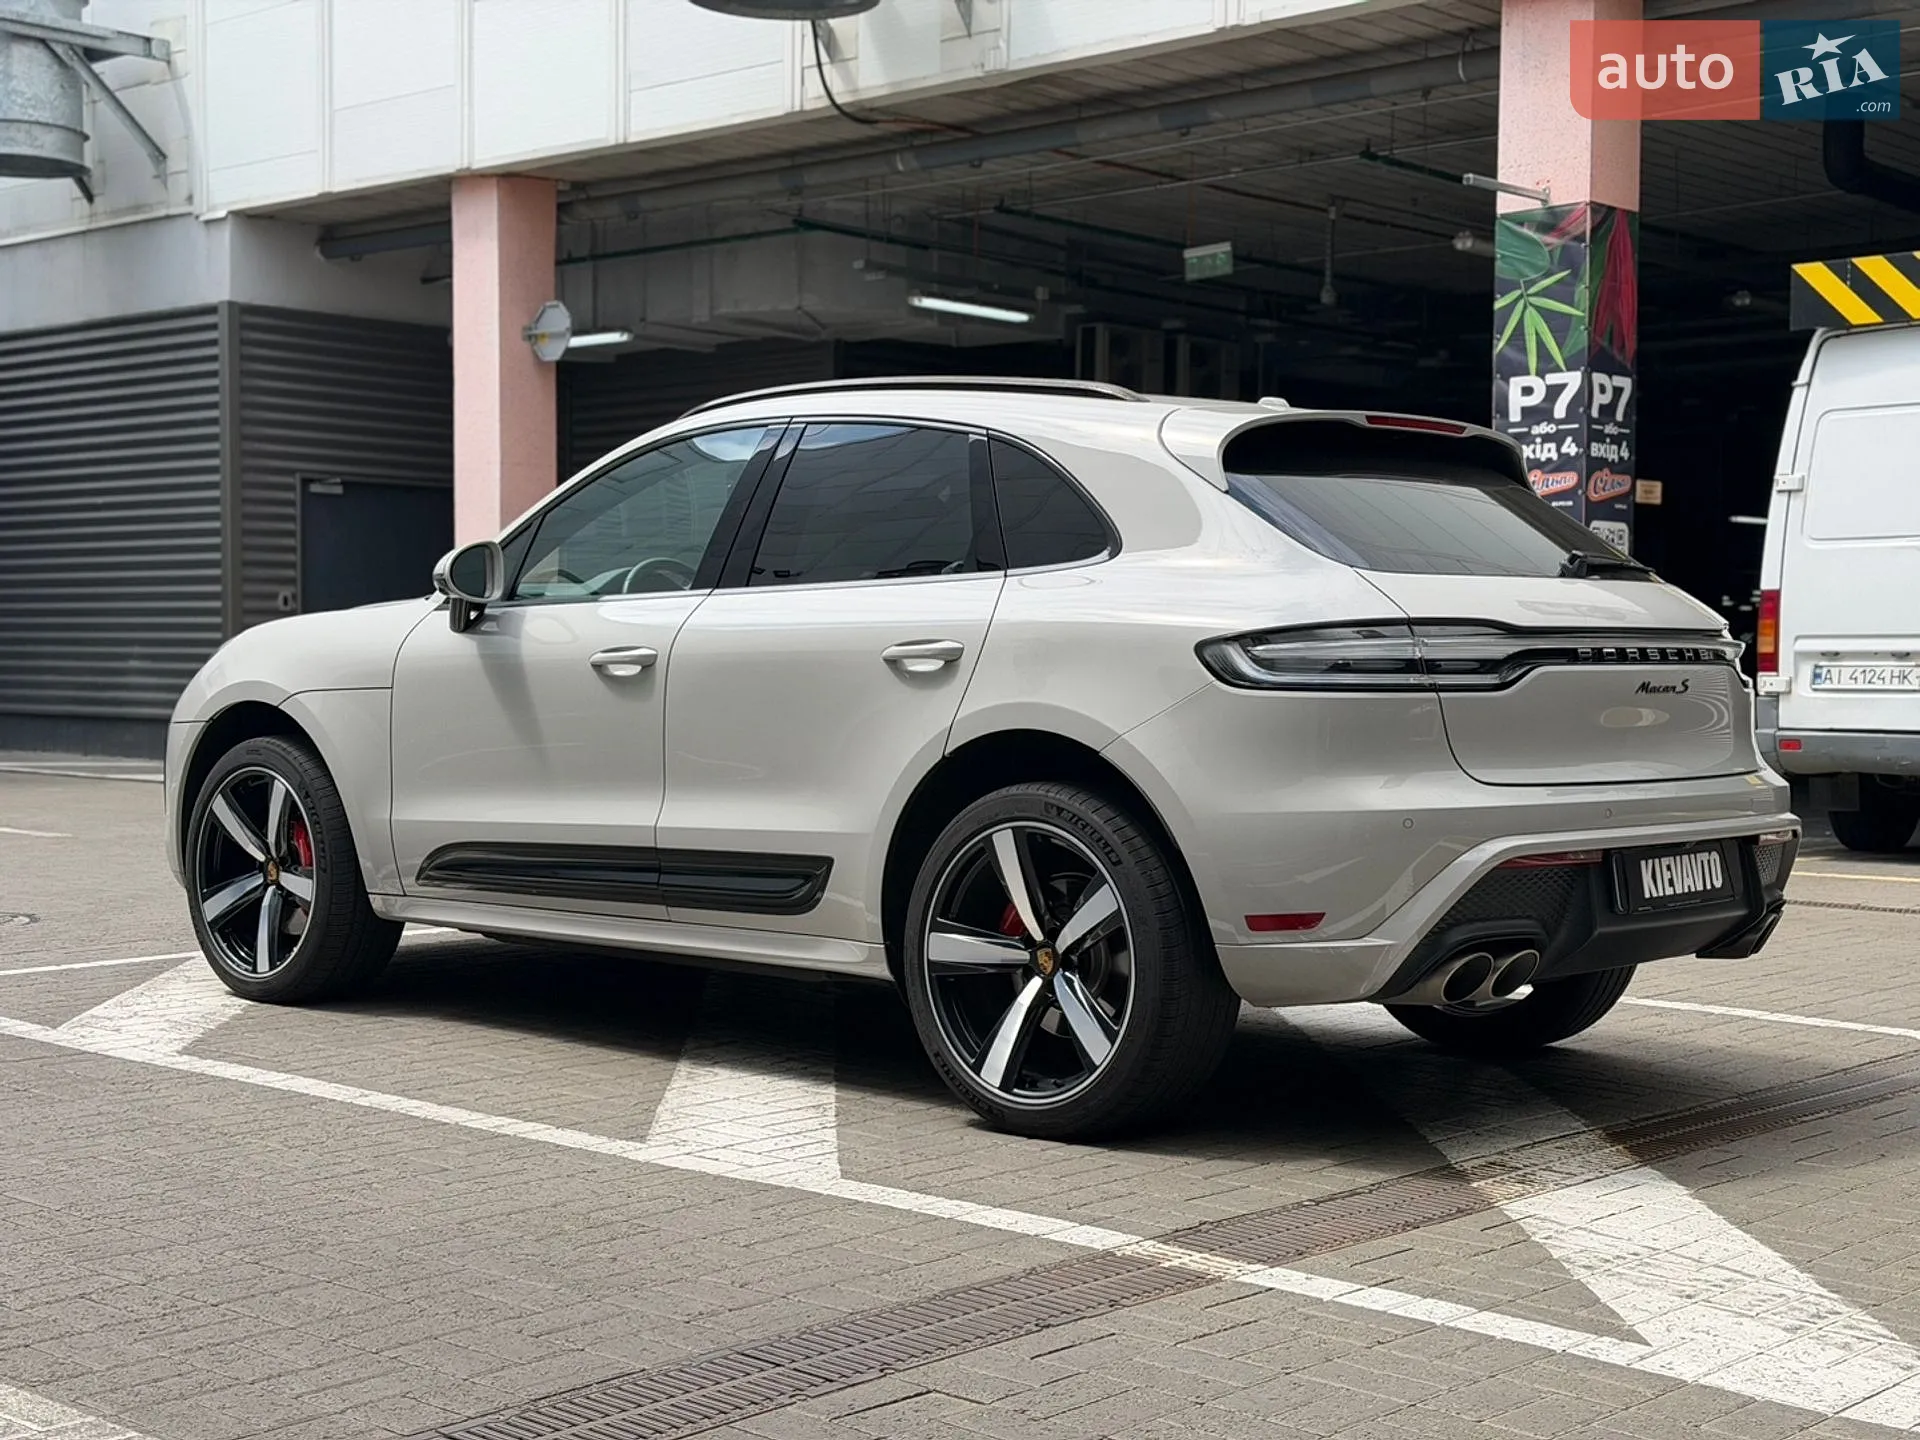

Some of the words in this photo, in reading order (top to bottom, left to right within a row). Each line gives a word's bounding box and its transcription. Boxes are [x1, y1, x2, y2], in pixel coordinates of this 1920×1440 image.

[1508, 370, 1582, 422] P7
[1591, 371, 1632, 421] P7
[1531, 421, 1557, 435] або
[1521, 437, 1558, 461] хід
[1560, 435, 1578, 457] 4
[1590, 437, 1618, 463] вхід
[1619, 440, 1630, 461] 4
[1635, 681, 1677, 694] Macan
[1676, 678, 1690, 694] S
[1823, 669, 1842, 685] AI
[1849, 668, 1886, 685] 4124
[1889, 669, 1914, 685] HK
